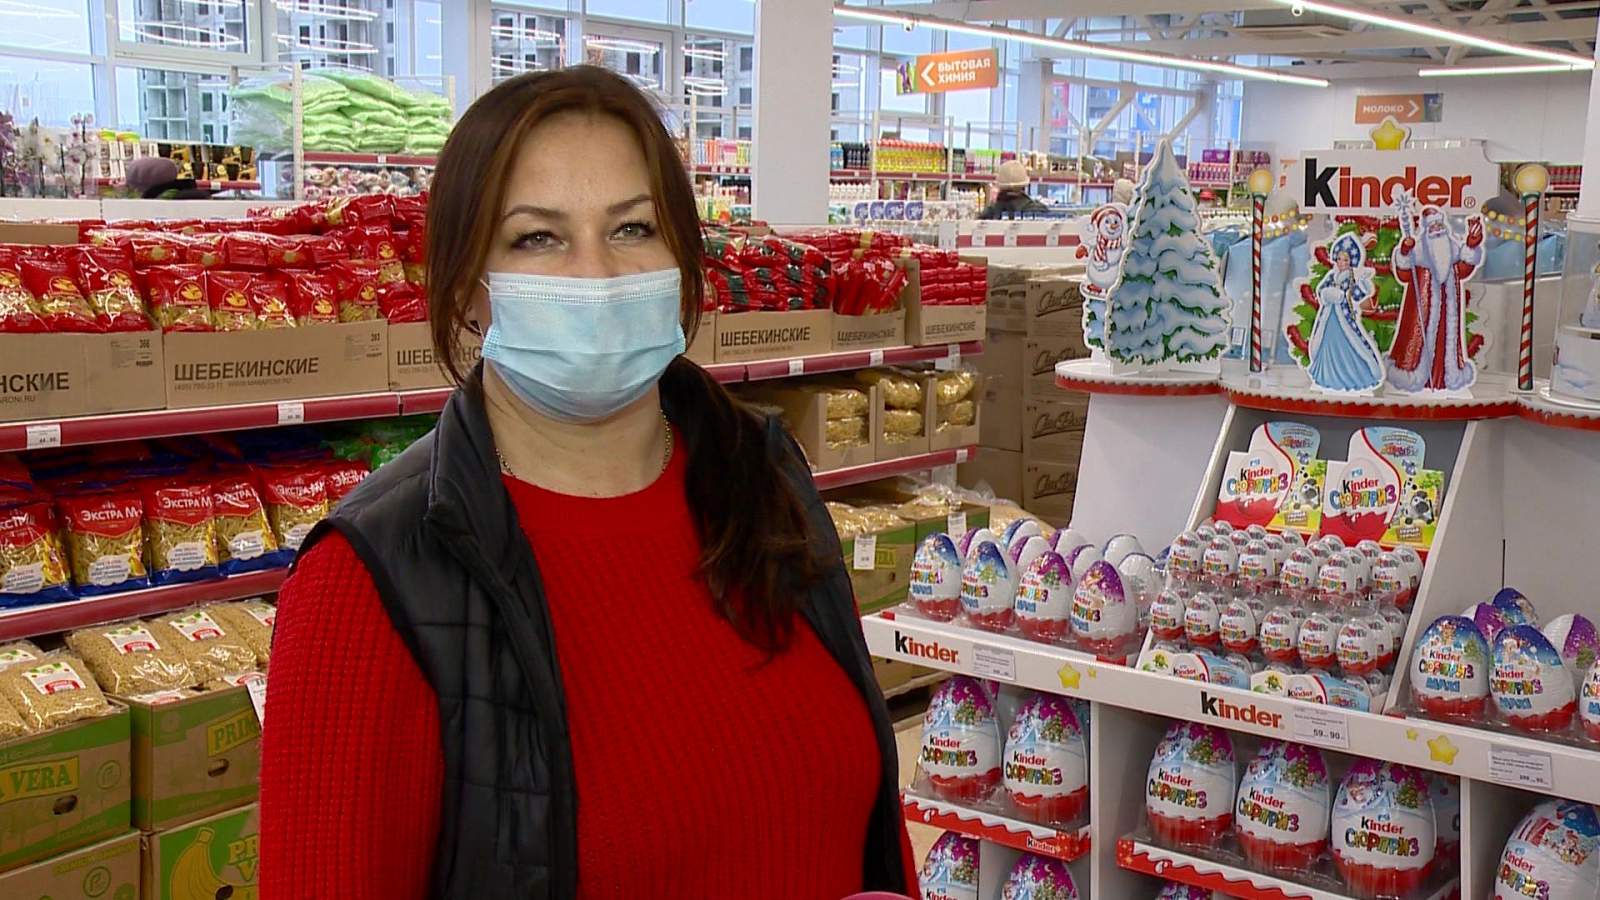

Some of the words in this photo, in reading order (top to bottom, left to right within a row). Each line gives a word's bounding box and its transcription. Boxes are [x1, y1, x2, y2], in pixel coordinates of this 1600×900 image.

[938, 58, 991, 72] БЫТОВАЯ
[938, 71, 976, 84] ХИМИЯ
[1363, 104, 1404, 113] МОЛОКО
[720, 326, 811, 347] ШЕБЕКИНСКИЕ
[174, 357, 320, 381] ШЕБЕКИНСКИЕ
[162, 497, 200, 509] ЭКСТРА
[80, 509, 123, 521] ЭКСТРА
[895, 630, 959, 663] Kinder
[1201, 690, 1282, 728] Kinder
[1361, 816, 1405, 834] Kinder
